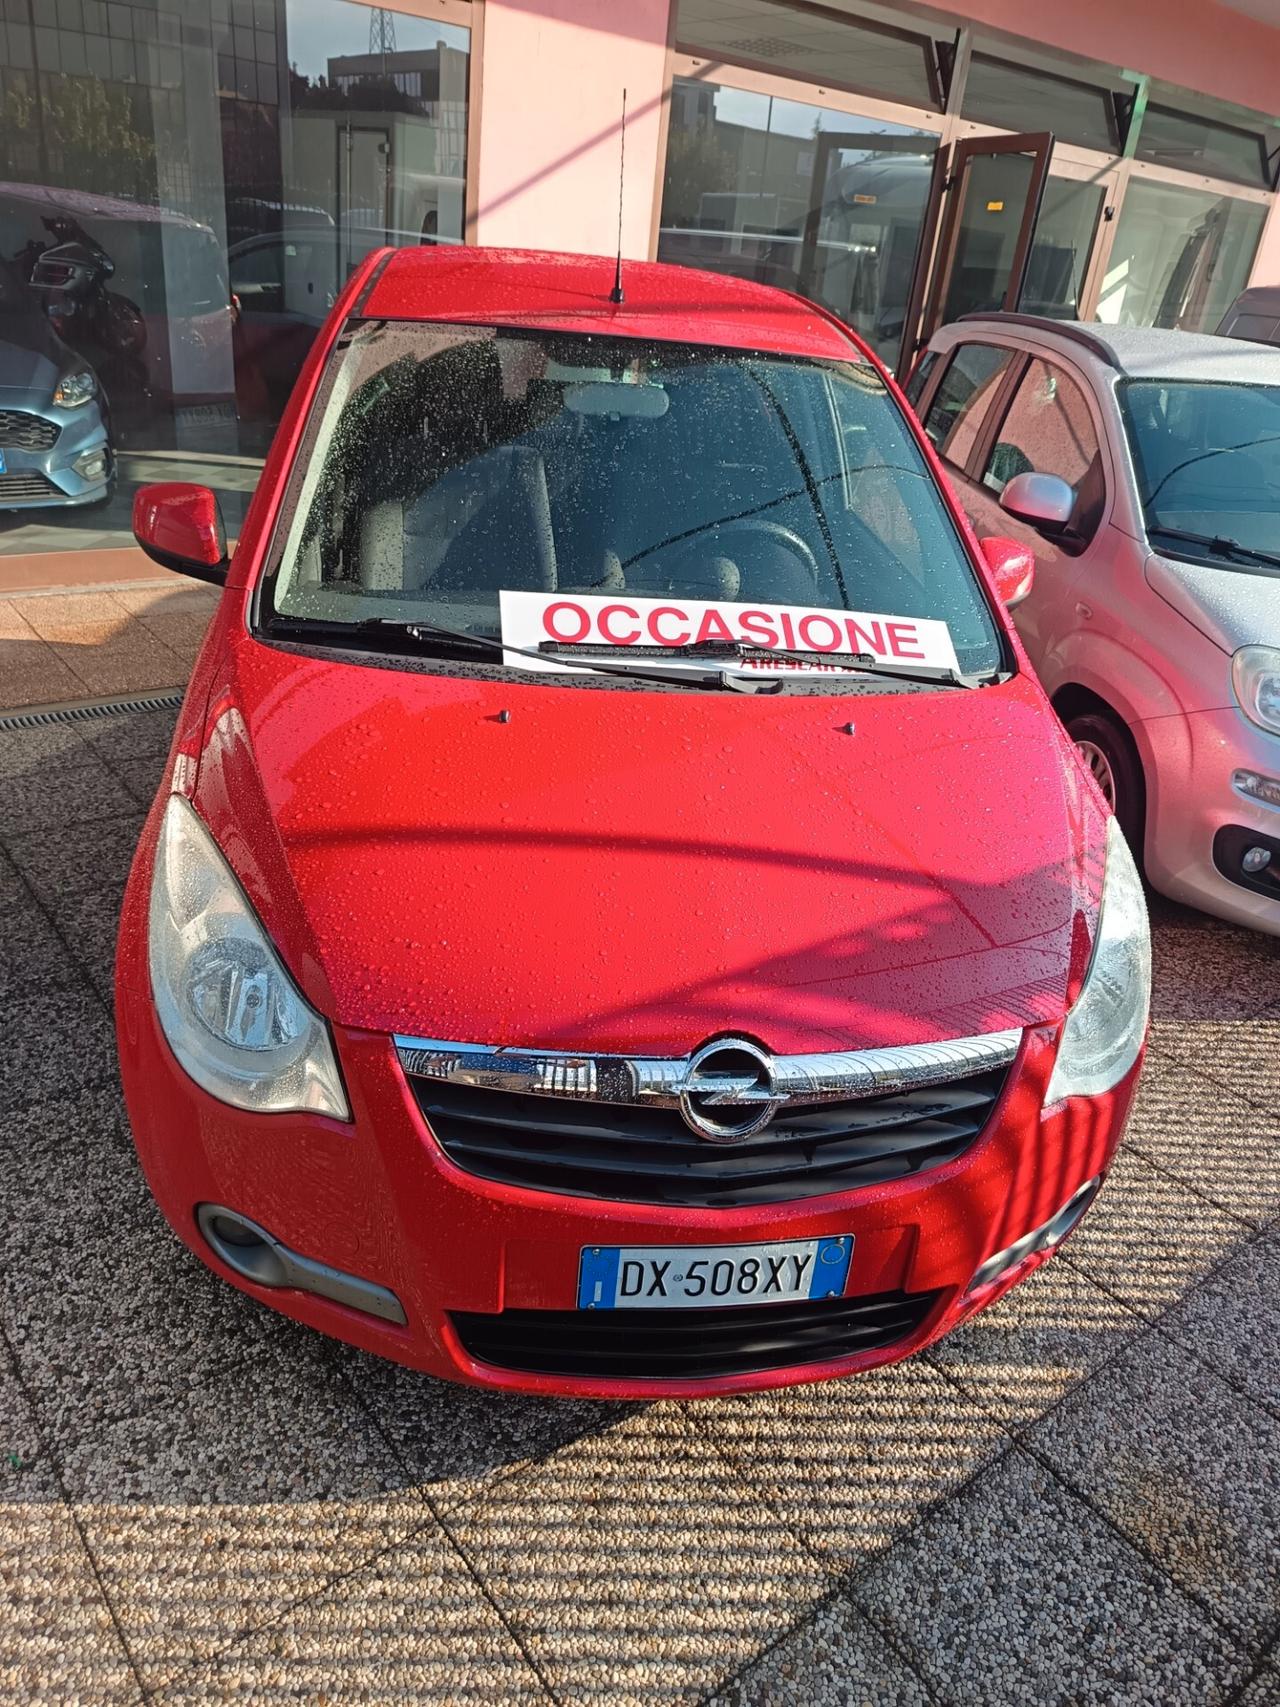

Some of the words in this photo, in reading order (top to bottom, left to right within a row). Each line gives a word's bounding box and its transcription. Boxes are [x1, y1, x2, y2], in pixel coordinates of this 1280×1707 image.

[542, 601, 926, 660] OCCASIONE
[620, 1260, 671, 1297] DX
[684, 1253, 813, 1296] 508XY
